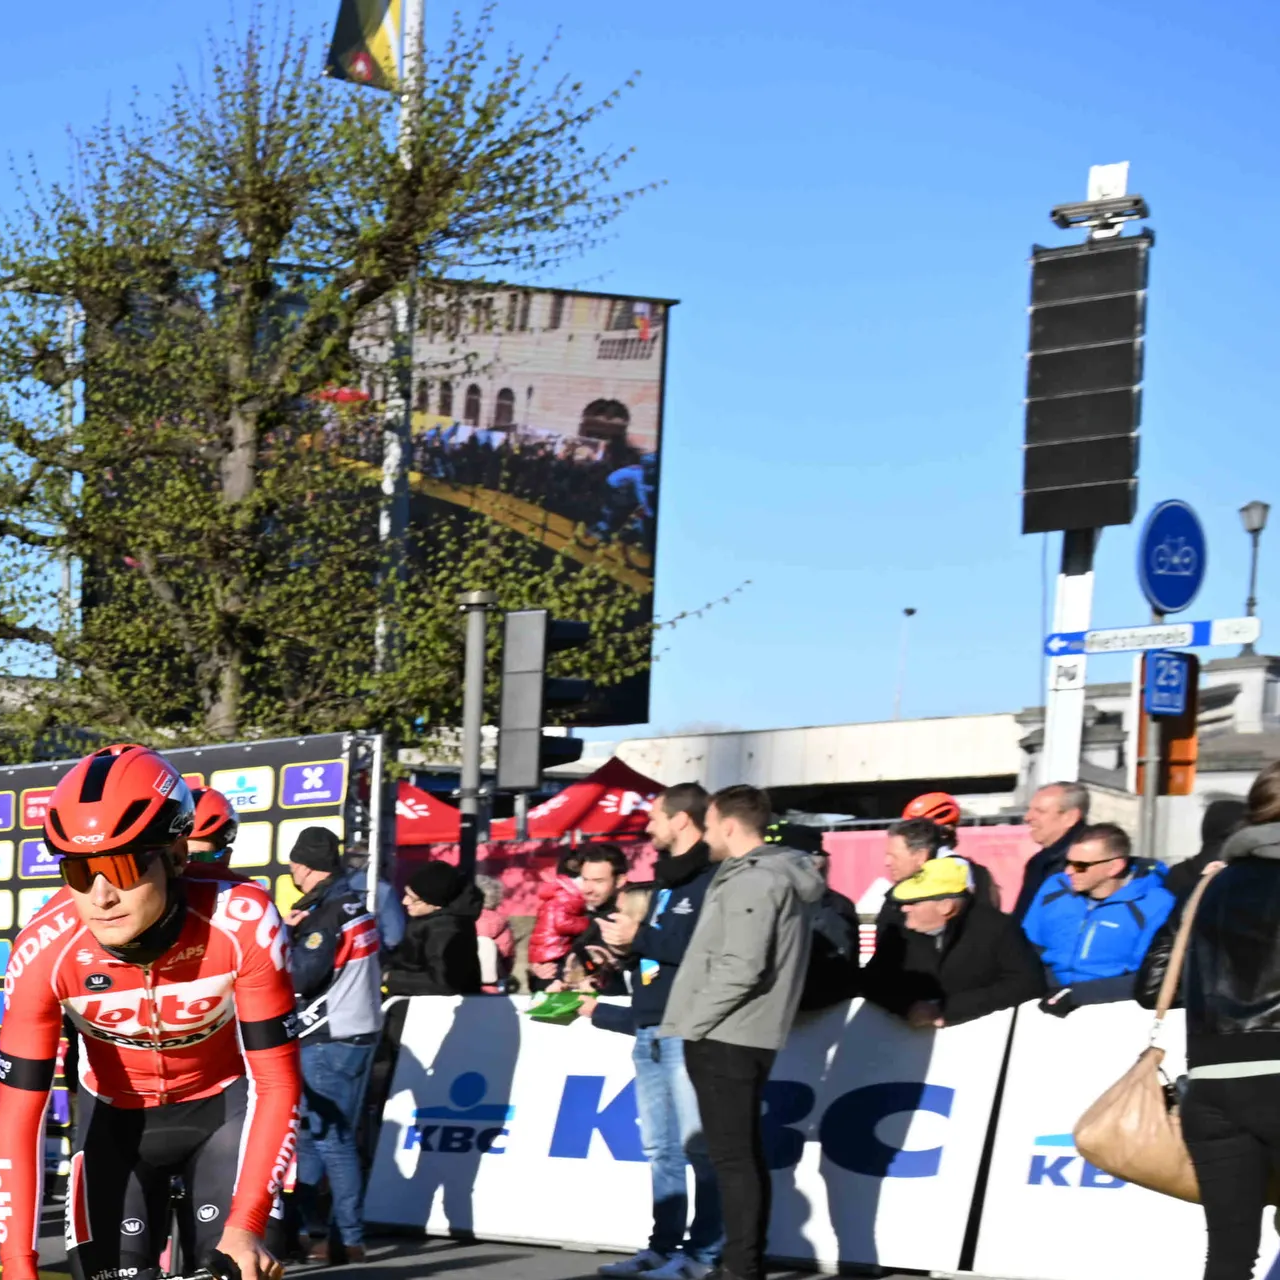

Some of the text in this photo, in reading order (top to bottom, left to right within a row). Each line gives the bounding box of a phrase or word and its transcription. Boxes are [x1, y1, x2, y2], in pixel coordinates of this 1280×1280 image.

[1155, 659, 1182, 687] 25
[402, 1122, 512, 1156] KBC
[1027, 1154, 1130, 1190] KB
